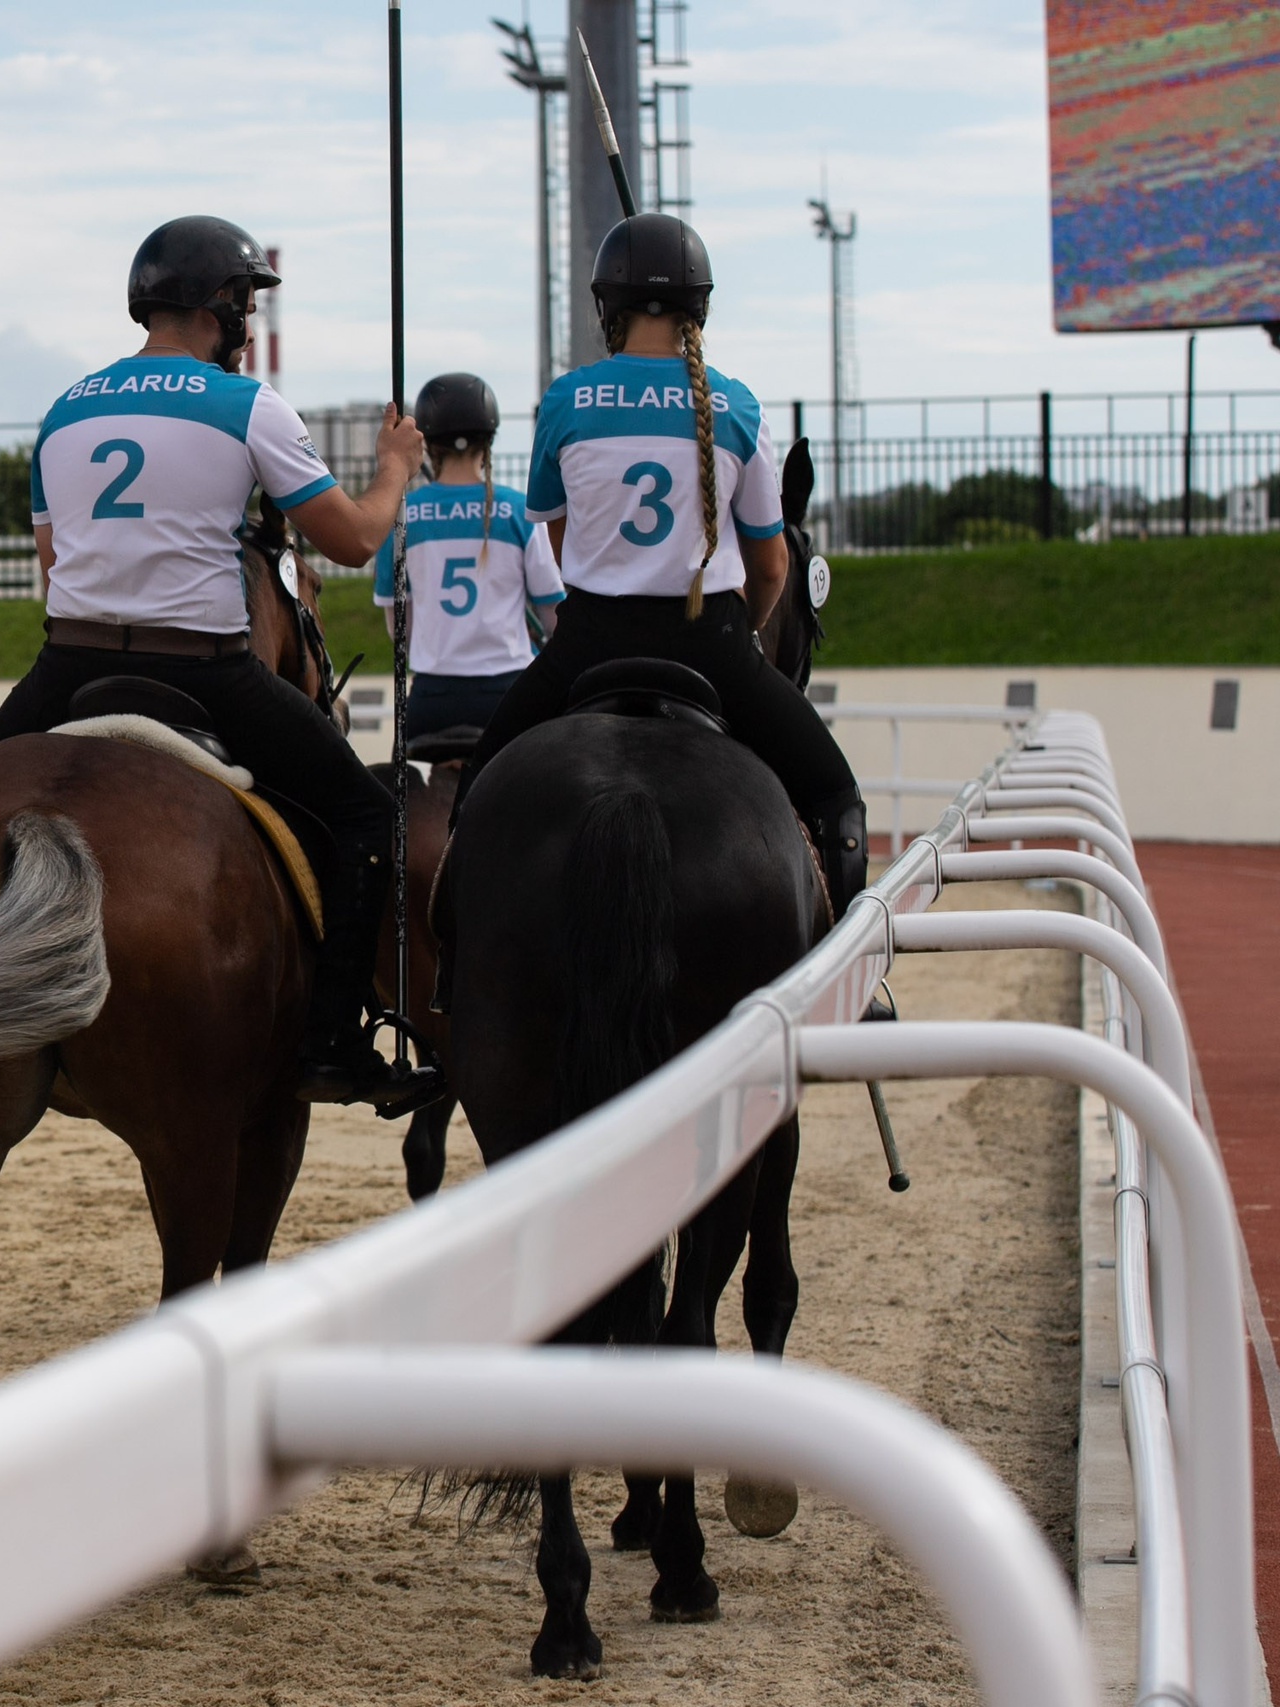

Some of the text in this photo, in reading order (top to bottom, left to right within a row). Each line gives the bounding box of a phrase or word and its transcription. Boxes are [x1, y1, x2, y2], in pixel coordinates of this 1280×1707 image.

[66, 374, 207, 401] BELARUS
[89, 438, 145, 520] 2
[619, 461, 675, 547] 3
[439, 556, 478, 617] 5
[814, 569, 825, 594] 19
